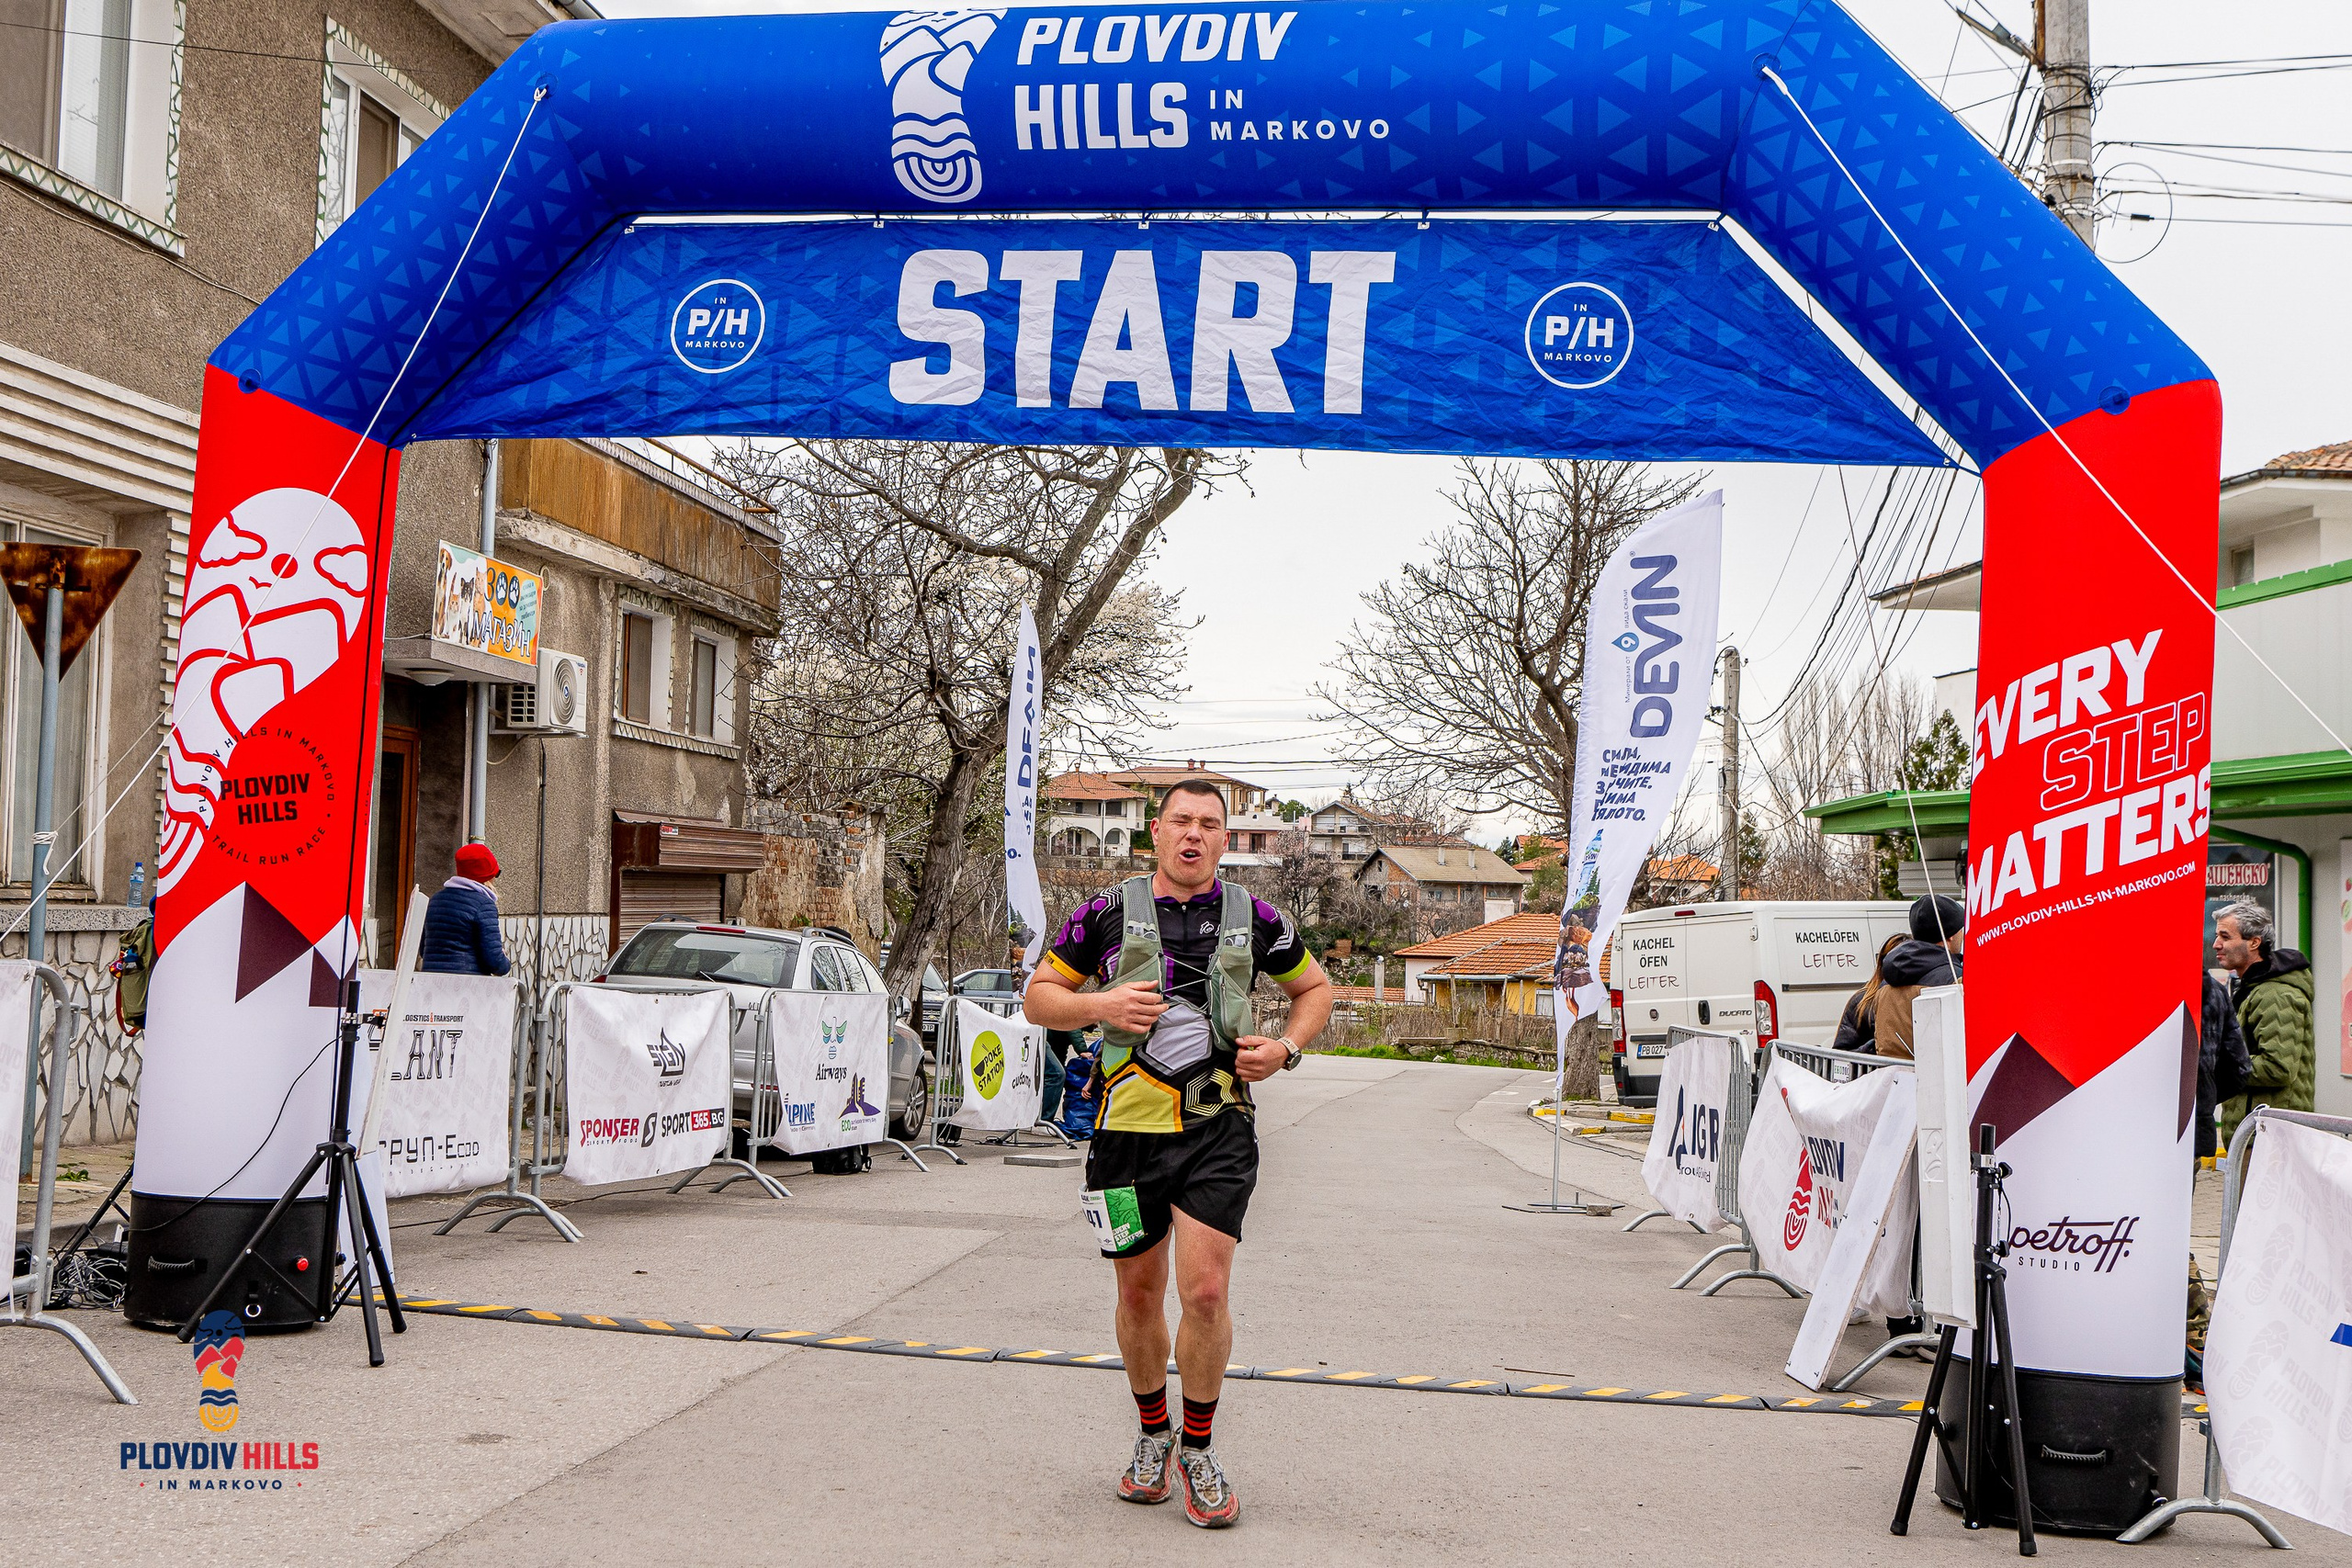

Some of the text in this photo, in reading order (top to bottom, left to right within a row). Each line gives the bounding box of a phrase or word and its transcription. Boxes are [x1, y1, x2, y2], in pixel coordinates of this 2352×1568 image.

[1016, 11, 1298, 65] PLOVDIV
[1209, 89, 1243, 109] IN
[1014, 82, 1189, 151] HILLS
[1210, 118, 1389, 141] MARKOVO
[687, 309, 750, 338] P/H
[888, 248, 1396, 415] START
[1544, 315, 1614, 349] P/H
[1544, 352, 1612, 363] MARKOVO
[472, 610, 531, 658] МАГАЗИН
[1630, 554, 1683, 738] DEVIN
[1972, 628, 2164, 785] EVERY
[2041, 692, 2205, 811] STEP
[198, 727, 335, 813] PLOVDIV HILLS IN MARKOVO
[220, 773, 311, 801] PLOVDIV
[237, 800, 299, 826] HILLS
[212, 828, 326, 865] TRAIL RUN RACE
[1964, 762, 2211, 935] MATTERS
[2206, 863, 2269, 886] АШЕНСКО
[1976, 861, 2196, 947] WWW.PLOVDIV-HILLS-IN-MARKOVO.COM
[1633, 937, 1675, 951] KACHEL
[1795, 929, 1860, 943] KACHELÖFEN
[1639, 954, 1668, 968] ÖFEN
[1803, 953, 1860, 968] LEITER
[1628, 976, 1679, 990] LEITER
[434, 1014, 464, 1022] TRANSPORT
[983, 1043, 1002, 1067] POKE
[816, 1064, 847, 1083] Airways
[978, 1058, 1004, 1092] STATION
[580, 1118, 639, 1147] SPONSER
[1082, 1208, 1102, 1228] 41
[2018, 1257, 2081, 1271] STUDIO
